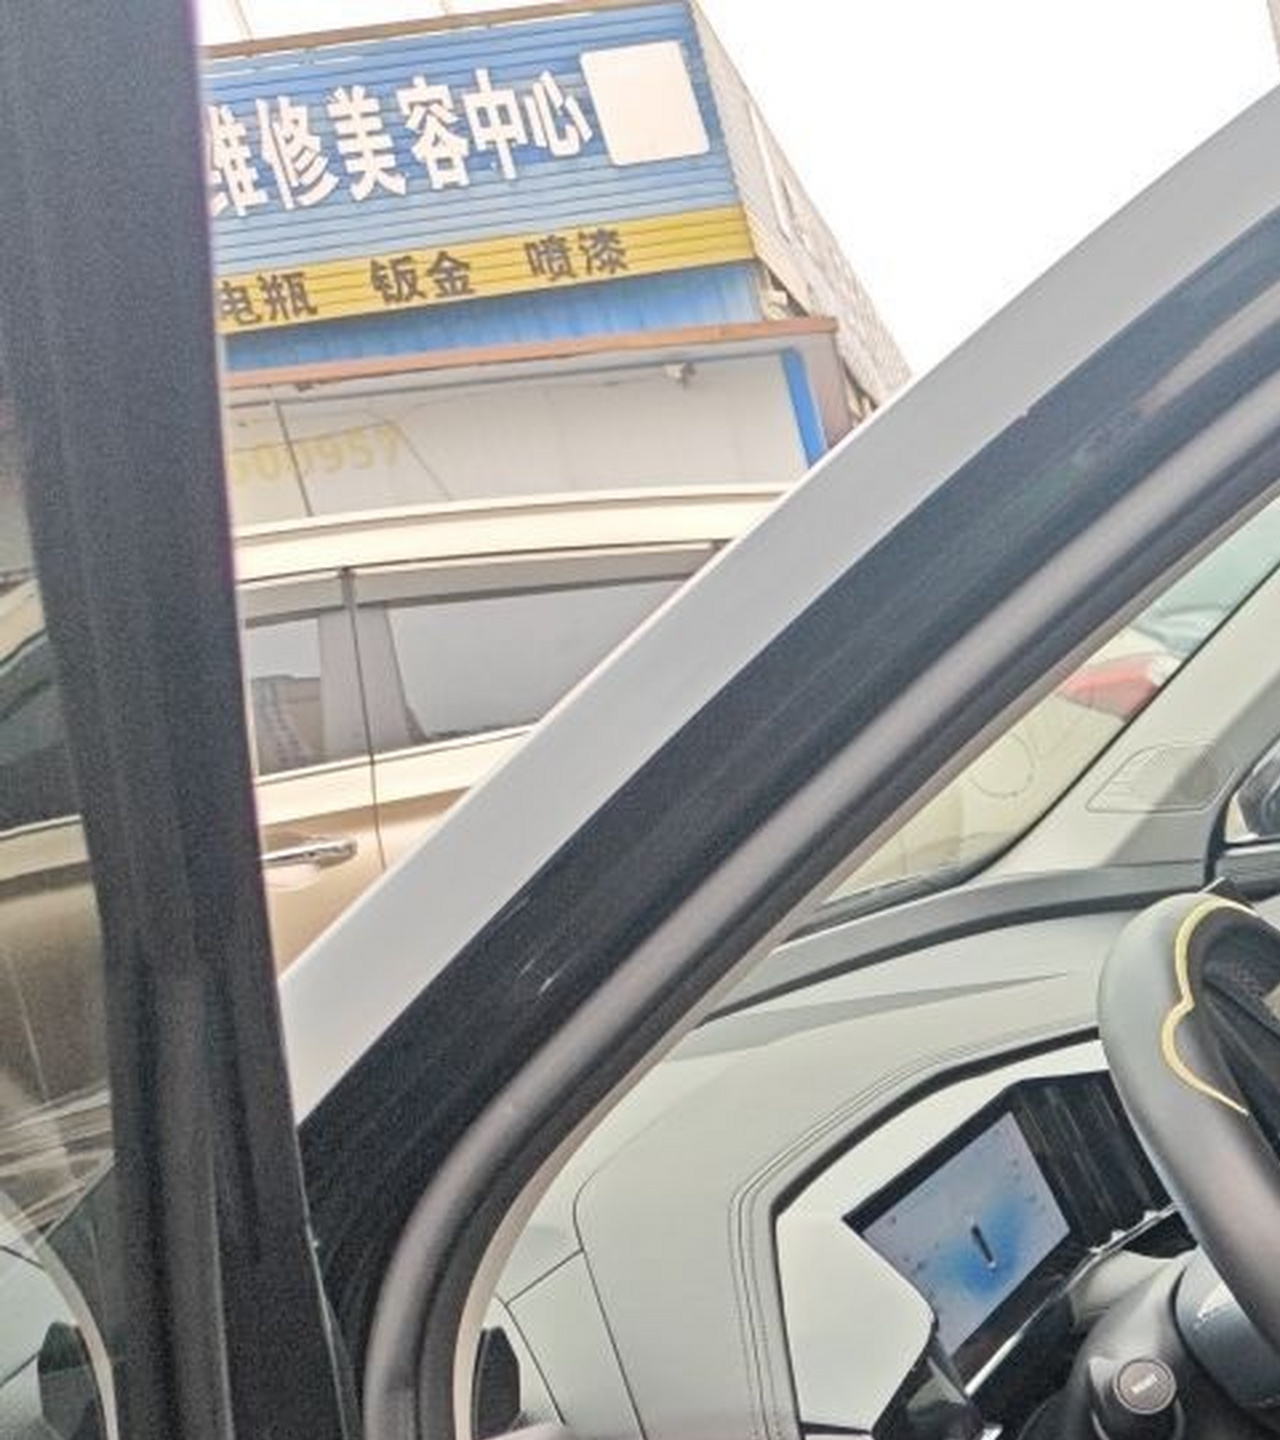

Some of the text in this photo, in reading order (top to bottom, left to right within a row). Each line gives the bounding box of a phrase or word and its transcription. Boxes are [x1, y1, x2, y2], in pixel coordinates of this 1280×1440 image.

[219, 228, 628, 325] 电瓶 钣金 喷漆
